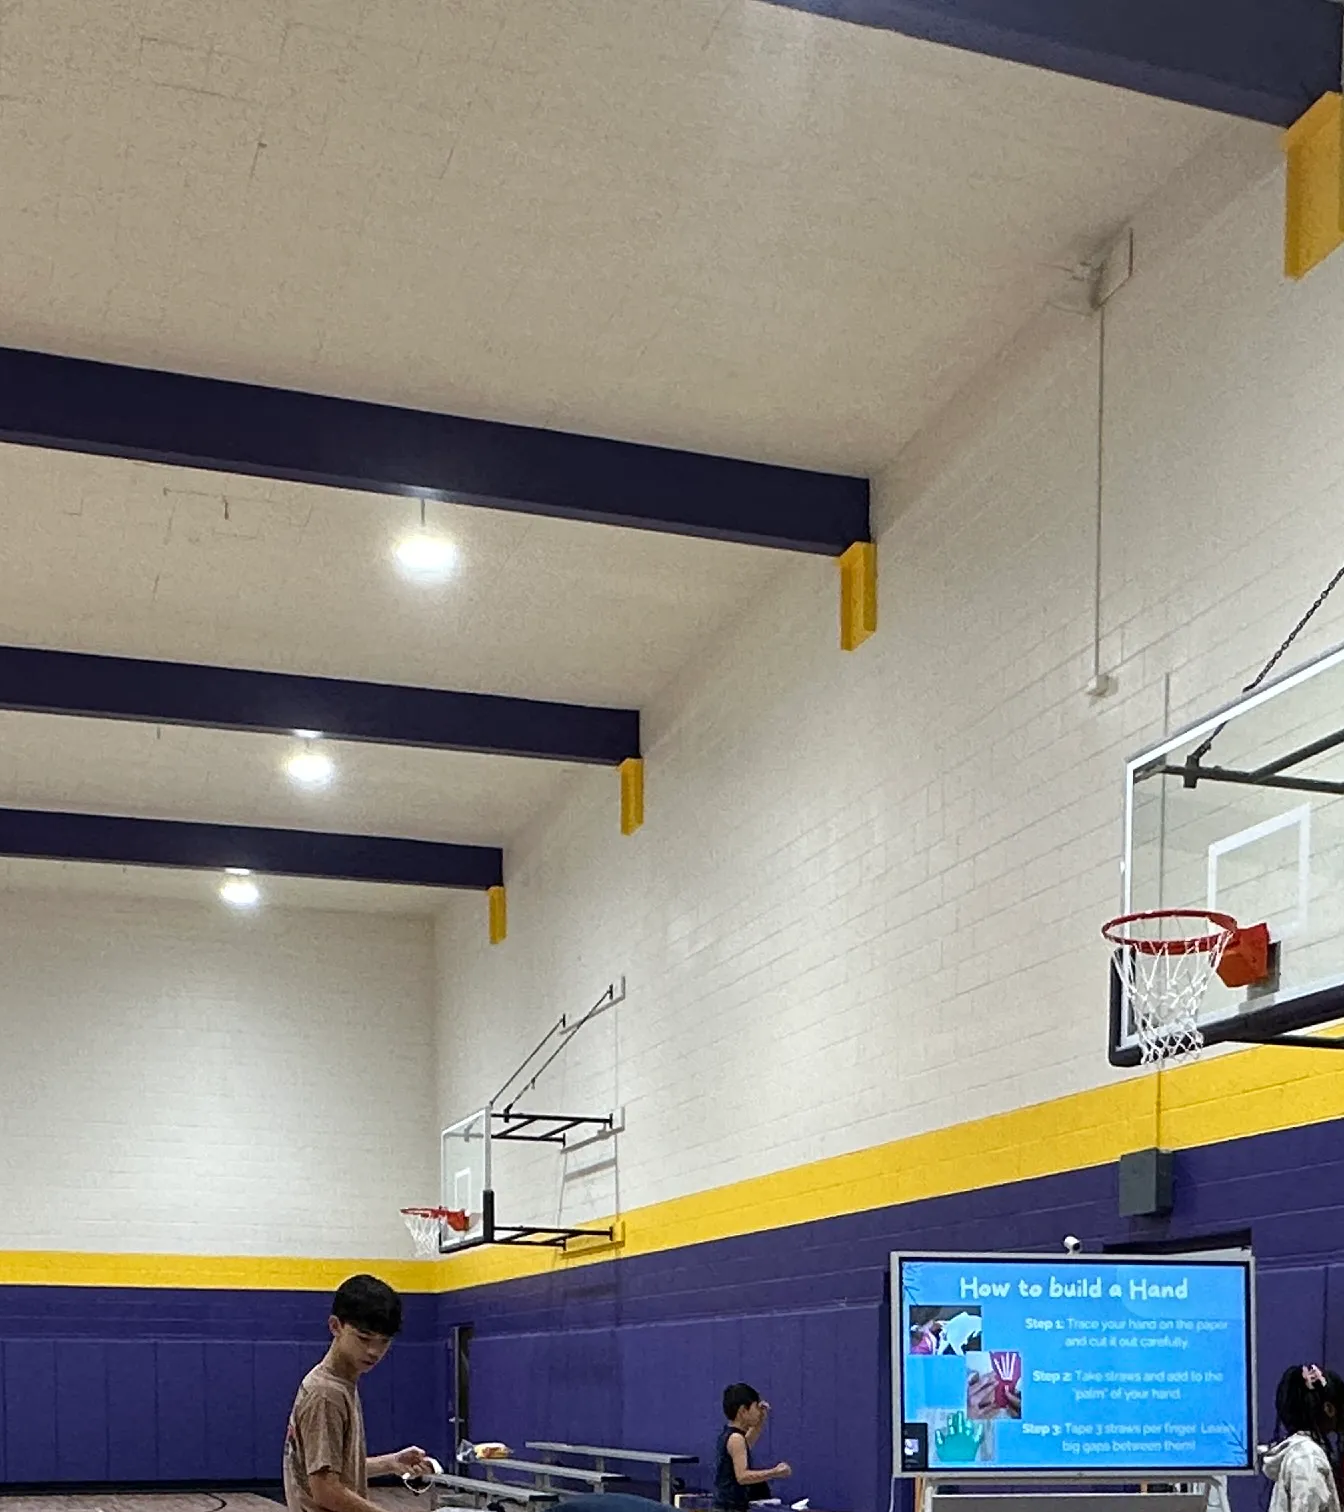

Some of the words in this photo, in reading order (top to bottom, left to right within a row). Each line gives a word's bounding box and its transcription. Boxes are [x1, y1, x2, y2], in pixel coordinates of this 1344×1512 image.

[960, 1276, 1011, 1299] How
[1018, 1279, 1043, 1297] to
[1049, 1276, 1102, 1298] build
[1109, 1283, 1122, 1298] a
[1129, 1278, 1189, 1300] Hand
[1025, 1318, 1053, 1331] Step
[1066, 1318, 1100, 1330] Trace
[1100, 1320, 1127, 1331] your
[1128, 1319, 1157, 1330] hand
[1158, 1320, 1174, 1330] on
[1176, 1319, 1194, 1330] the
[1196, 1320, 1228, 1332] paper
[1065, 1336, 1087, 1347] and
[1088, 1337, 1107, 1347] cut
[1109, 1336, 1117, 1347] it
[1119, 1337, 1138, 1347] out
[1033, 1369, 1060, 1384] Step
[1075, 1370, 1103, 1382] Take
[1104, 1370, 1142, 1382] straws
[1143, 1371, 1165, 1382] and
[1166, 1371, 1189, 1382] add
[1191, 1371, 1203, 1382] to
[1204, 1371, 1224, 1382] the
[1110, 1386, 1122, 1399] of
[1124, 1389, 1149, 1401] your
[1022, 1422, 1050, 1436] Step
[1064, 1422, 1093, 1435] Tape
[1096, 1424, 1103, 1435] 3
[1104, 1423, 1141, 1434] straws
[1142, 1424, 1162, 1436] per
[1062, 1440, 1080, 1454] big
[1082, 1442, 1111, 1453] gaps
[1112, 1440, 1162, 1452] between
